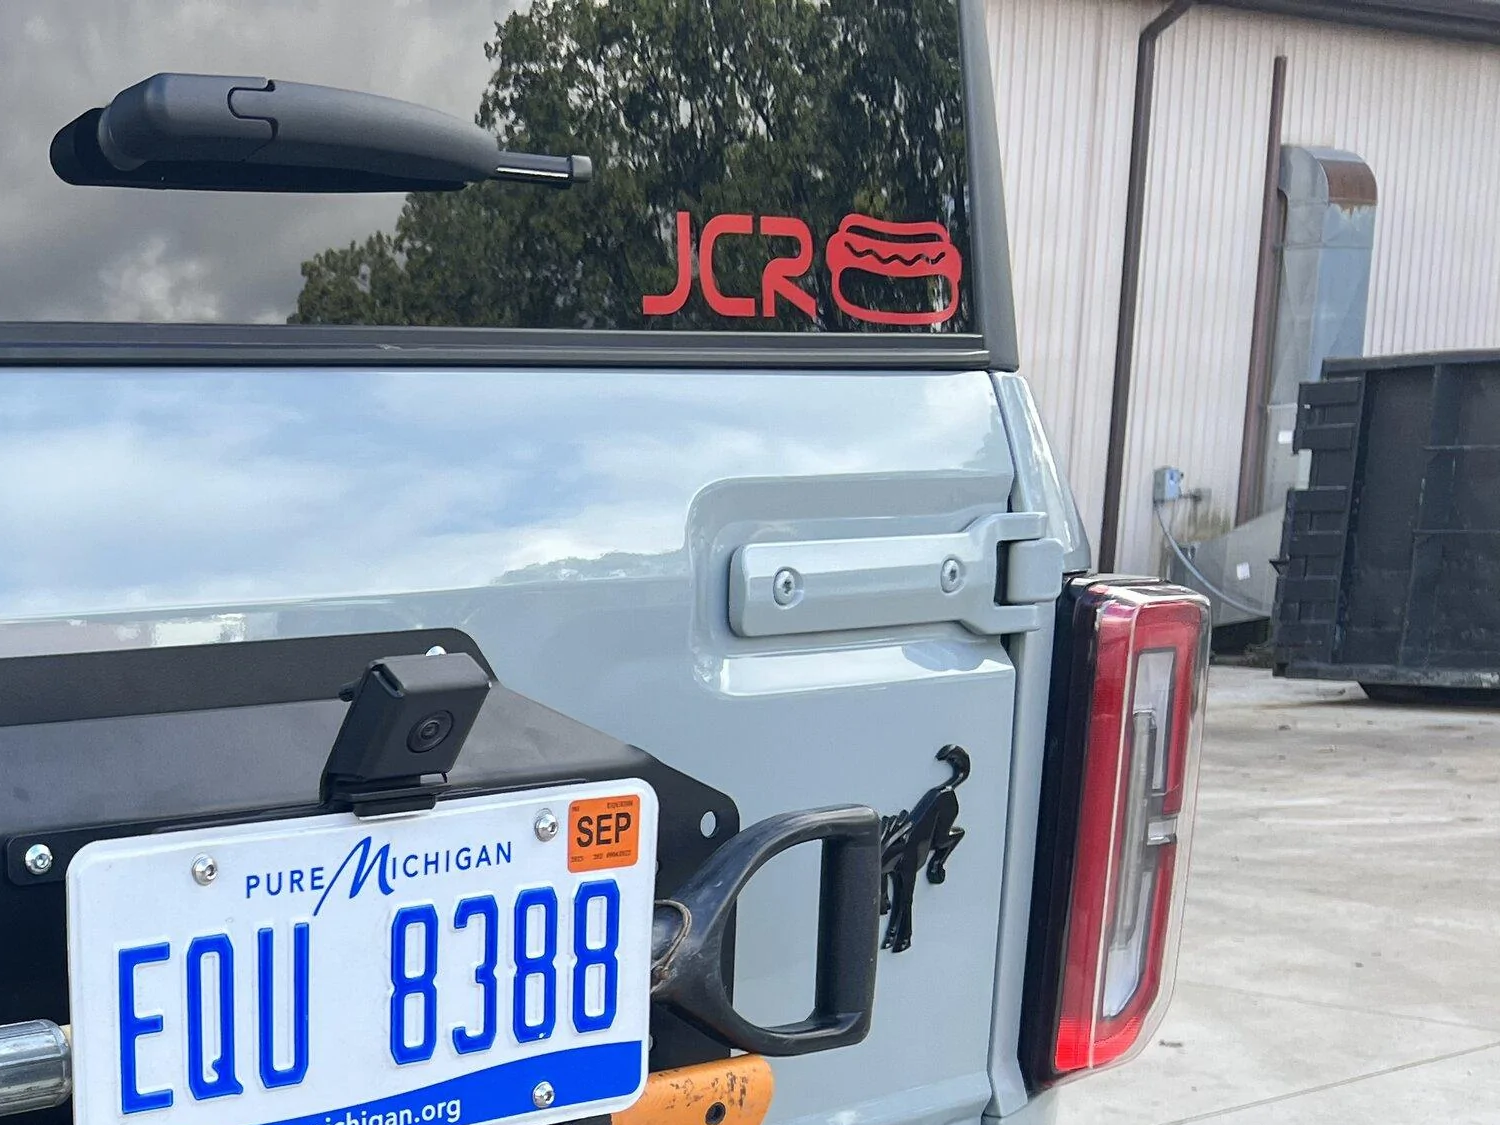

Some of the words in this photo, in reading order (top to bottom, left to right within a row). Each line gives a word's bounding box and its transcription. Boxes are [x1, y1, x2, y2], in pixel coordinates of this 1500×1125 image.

[642, 211, 817, 318] JCR
[246, 866, 325, 899] PURE
[312, 836, 512, 917] MICHIGAN
[576, 812, 632, 848] SEP
[118, 920, 310, 1115] EQU
[389, 879, 621, 1066] 8388
